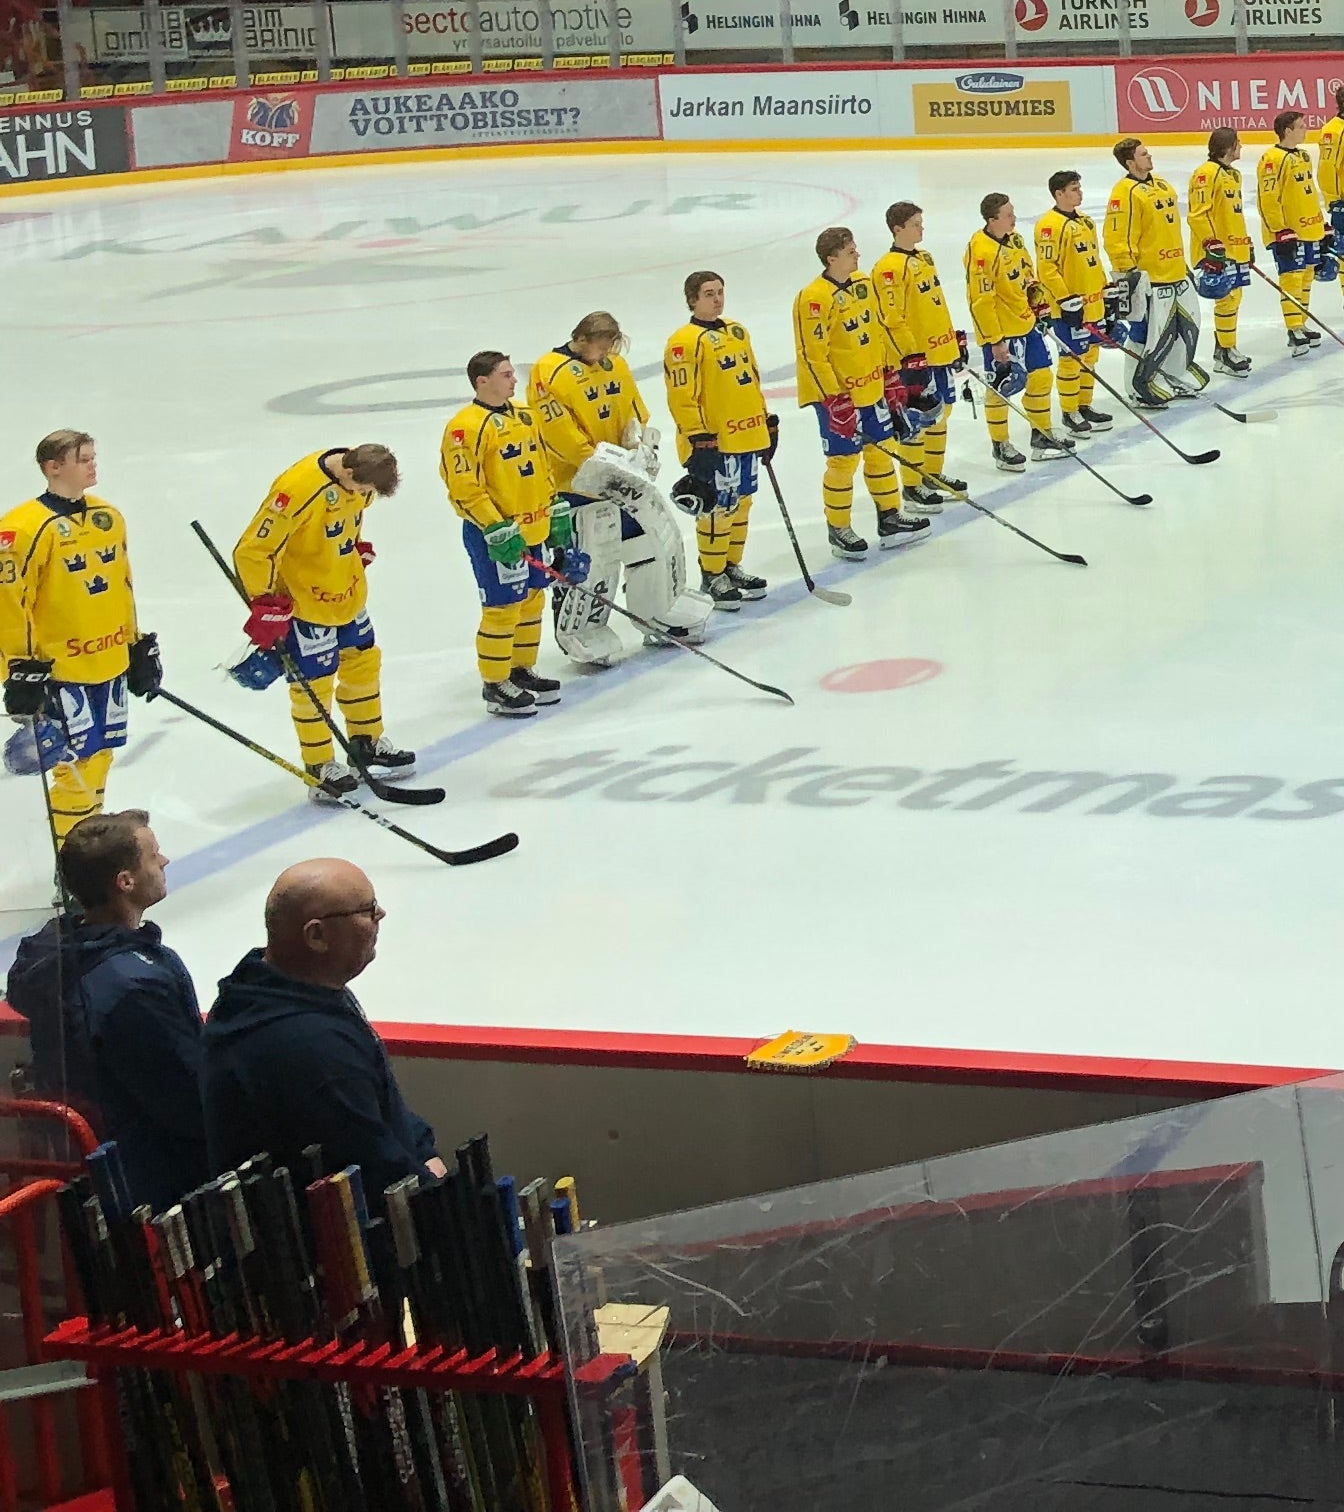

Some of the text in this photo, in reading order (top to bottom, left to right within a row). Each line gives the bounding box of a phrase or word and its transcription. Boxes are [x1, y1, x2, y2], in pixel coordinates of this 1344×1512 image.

[706, 13, 822, 29] HELSINGIN IHNA
[943, 8, 987, 25] HIHNA
[1058, 12, 1150, 31] AIRLINES
[349, 88, 519, 118] AUKEAAKO
[670, 93, 873, 119] Jarkan Maansiirto
[928, 98, 1056, 119] REISSUMIES
[349, 107, 581, 137] VOITTOBISSET?
[240, 128, 300, 149] KOFF
[812, 322, 824, 341] 4
[671, 367, 689, 388] 10
[540, 398, 564, 423] 30
[453, 453, 472, 475] 21
[256, 517, 274, 539] 6
